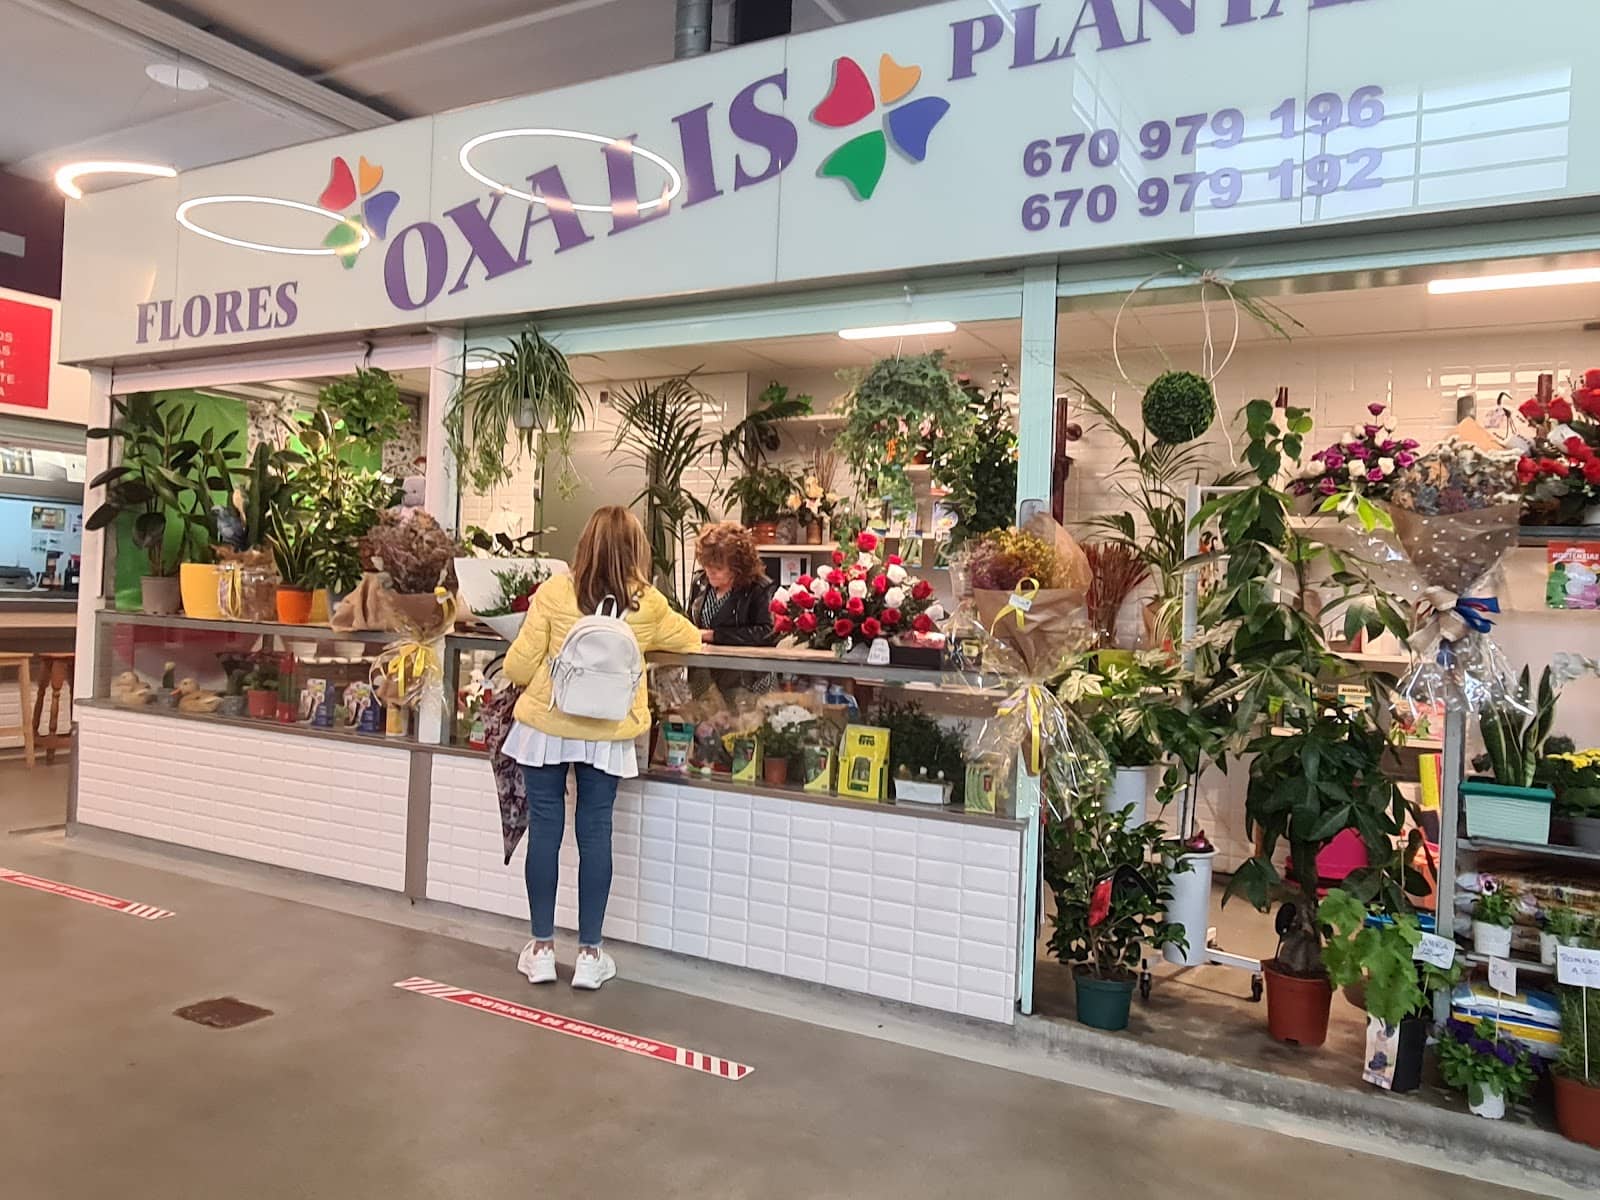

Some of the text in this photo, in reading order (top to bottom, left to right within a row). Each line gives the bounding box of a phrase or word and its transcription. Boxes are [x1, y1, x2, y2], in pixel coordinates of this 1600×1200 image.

[1022, 85, 1384, 177] 670 979 196
[384, 68, 798, 311] OXALIS
[1021, 147, 1383, 232] 670 979 192
[136, 281, 299, 344] FLORES
[468, 996, 541, 1021] DISTANCIA
[541, 1017, 560, 1027] DE
[563, 1022, 659, 1053] SEGURIDADE
